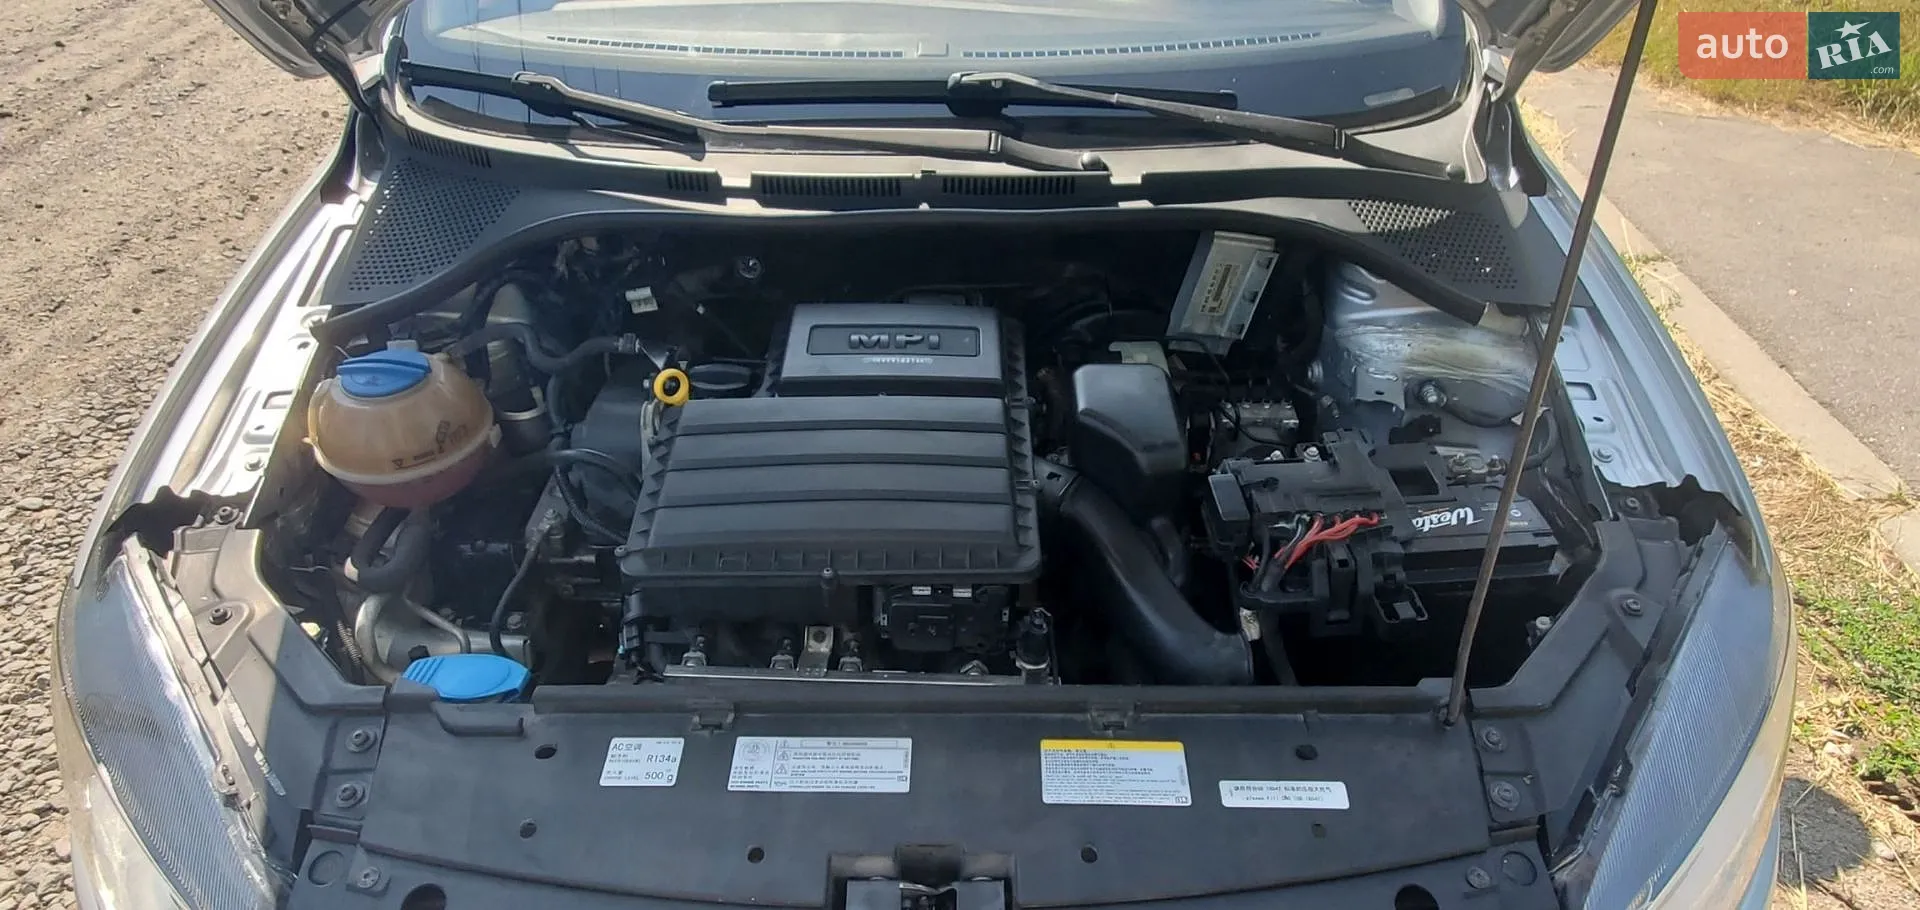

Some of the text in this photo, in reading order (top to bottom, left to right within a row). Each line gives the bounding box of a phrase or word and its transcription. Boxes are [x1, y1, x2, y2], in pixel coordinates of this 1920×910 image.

[849, 332, 940, 350] MPI
[646, 754, 677, 763] R134a
[645, 771, 664, 780] 500
